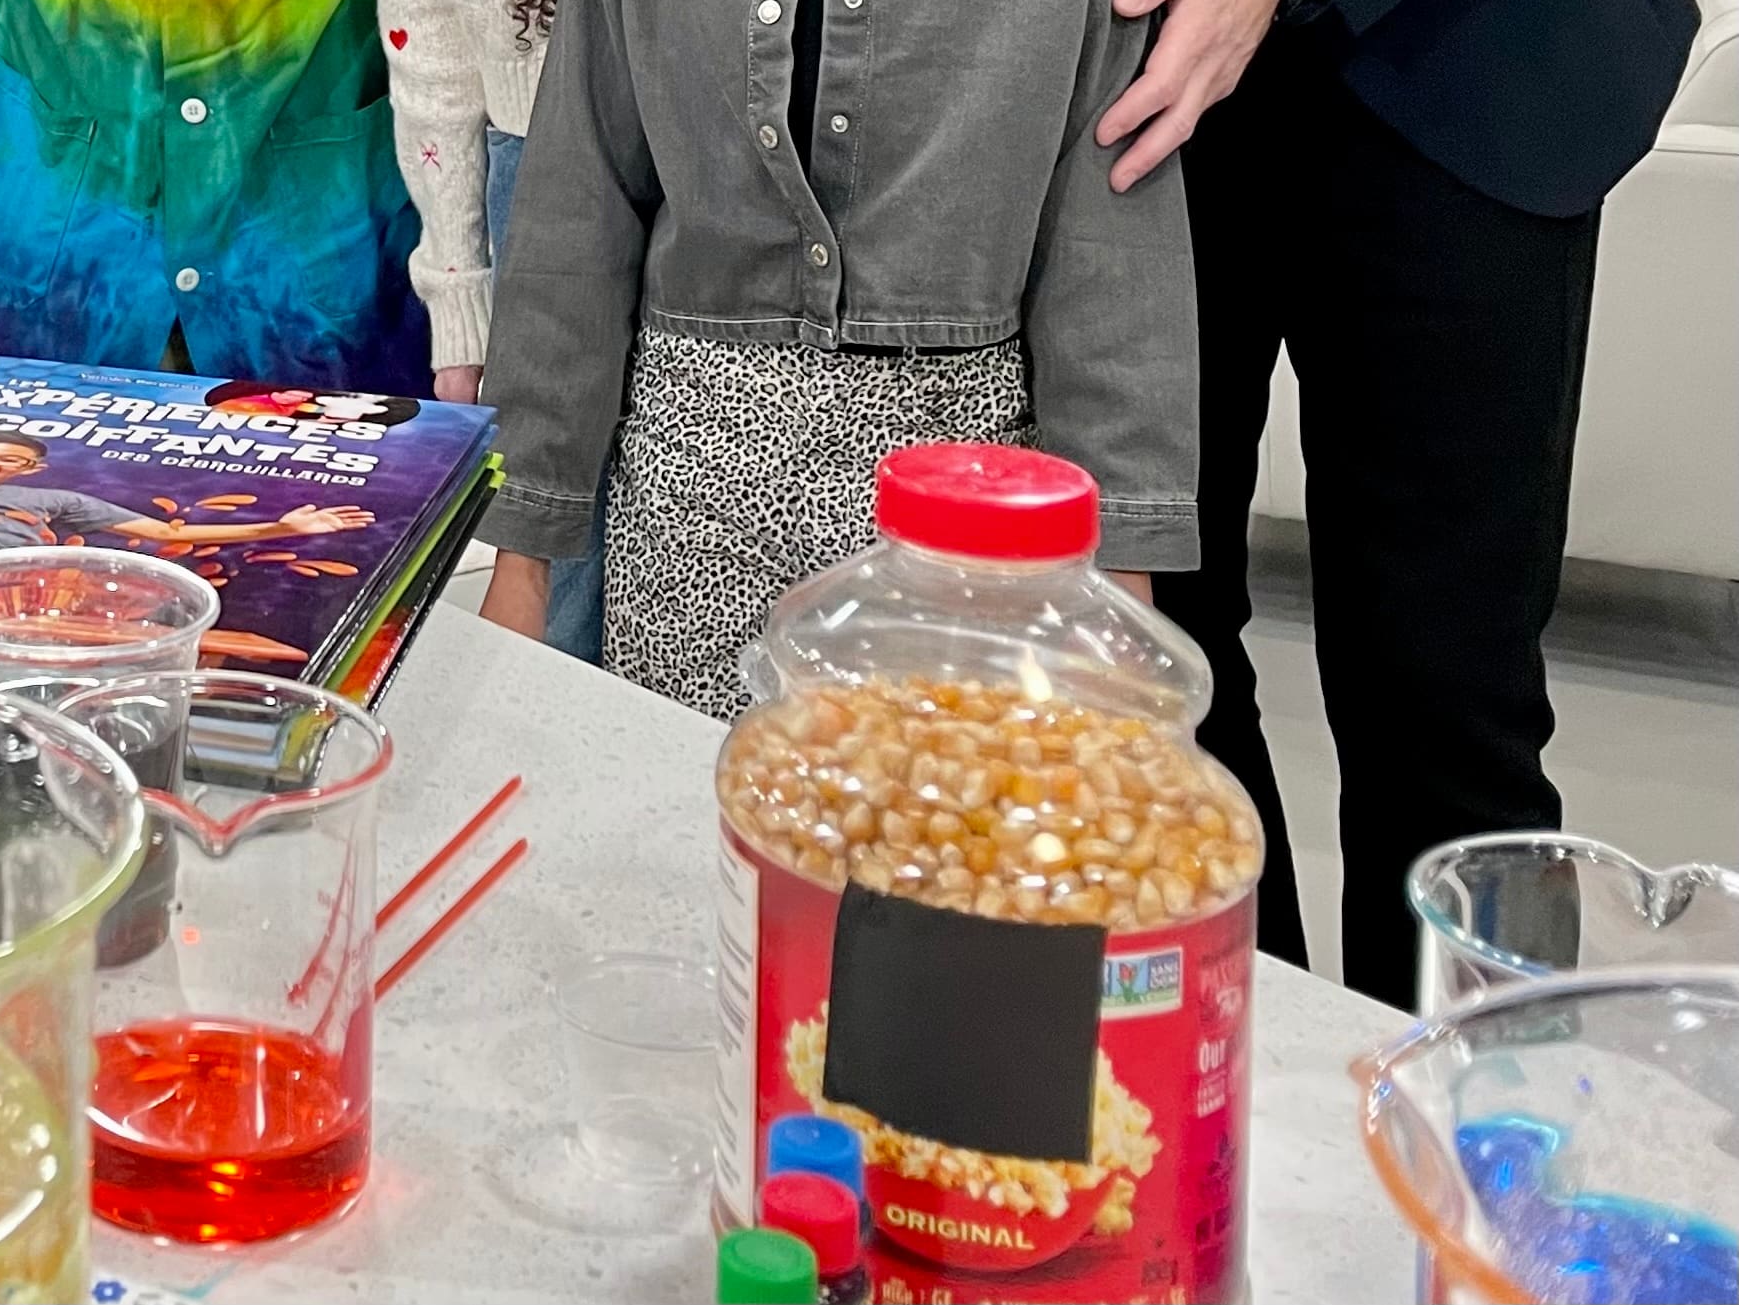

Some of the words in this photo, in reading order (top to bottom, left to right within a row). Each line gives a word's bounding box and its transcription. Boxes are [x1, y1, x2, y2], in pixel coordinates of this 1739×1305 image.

[101, 449, 152, 463] DES
[160, 455, 367, 487] DÉBROUILLARDS
[885, 1203, 1036, 1250] ORIGINAL
